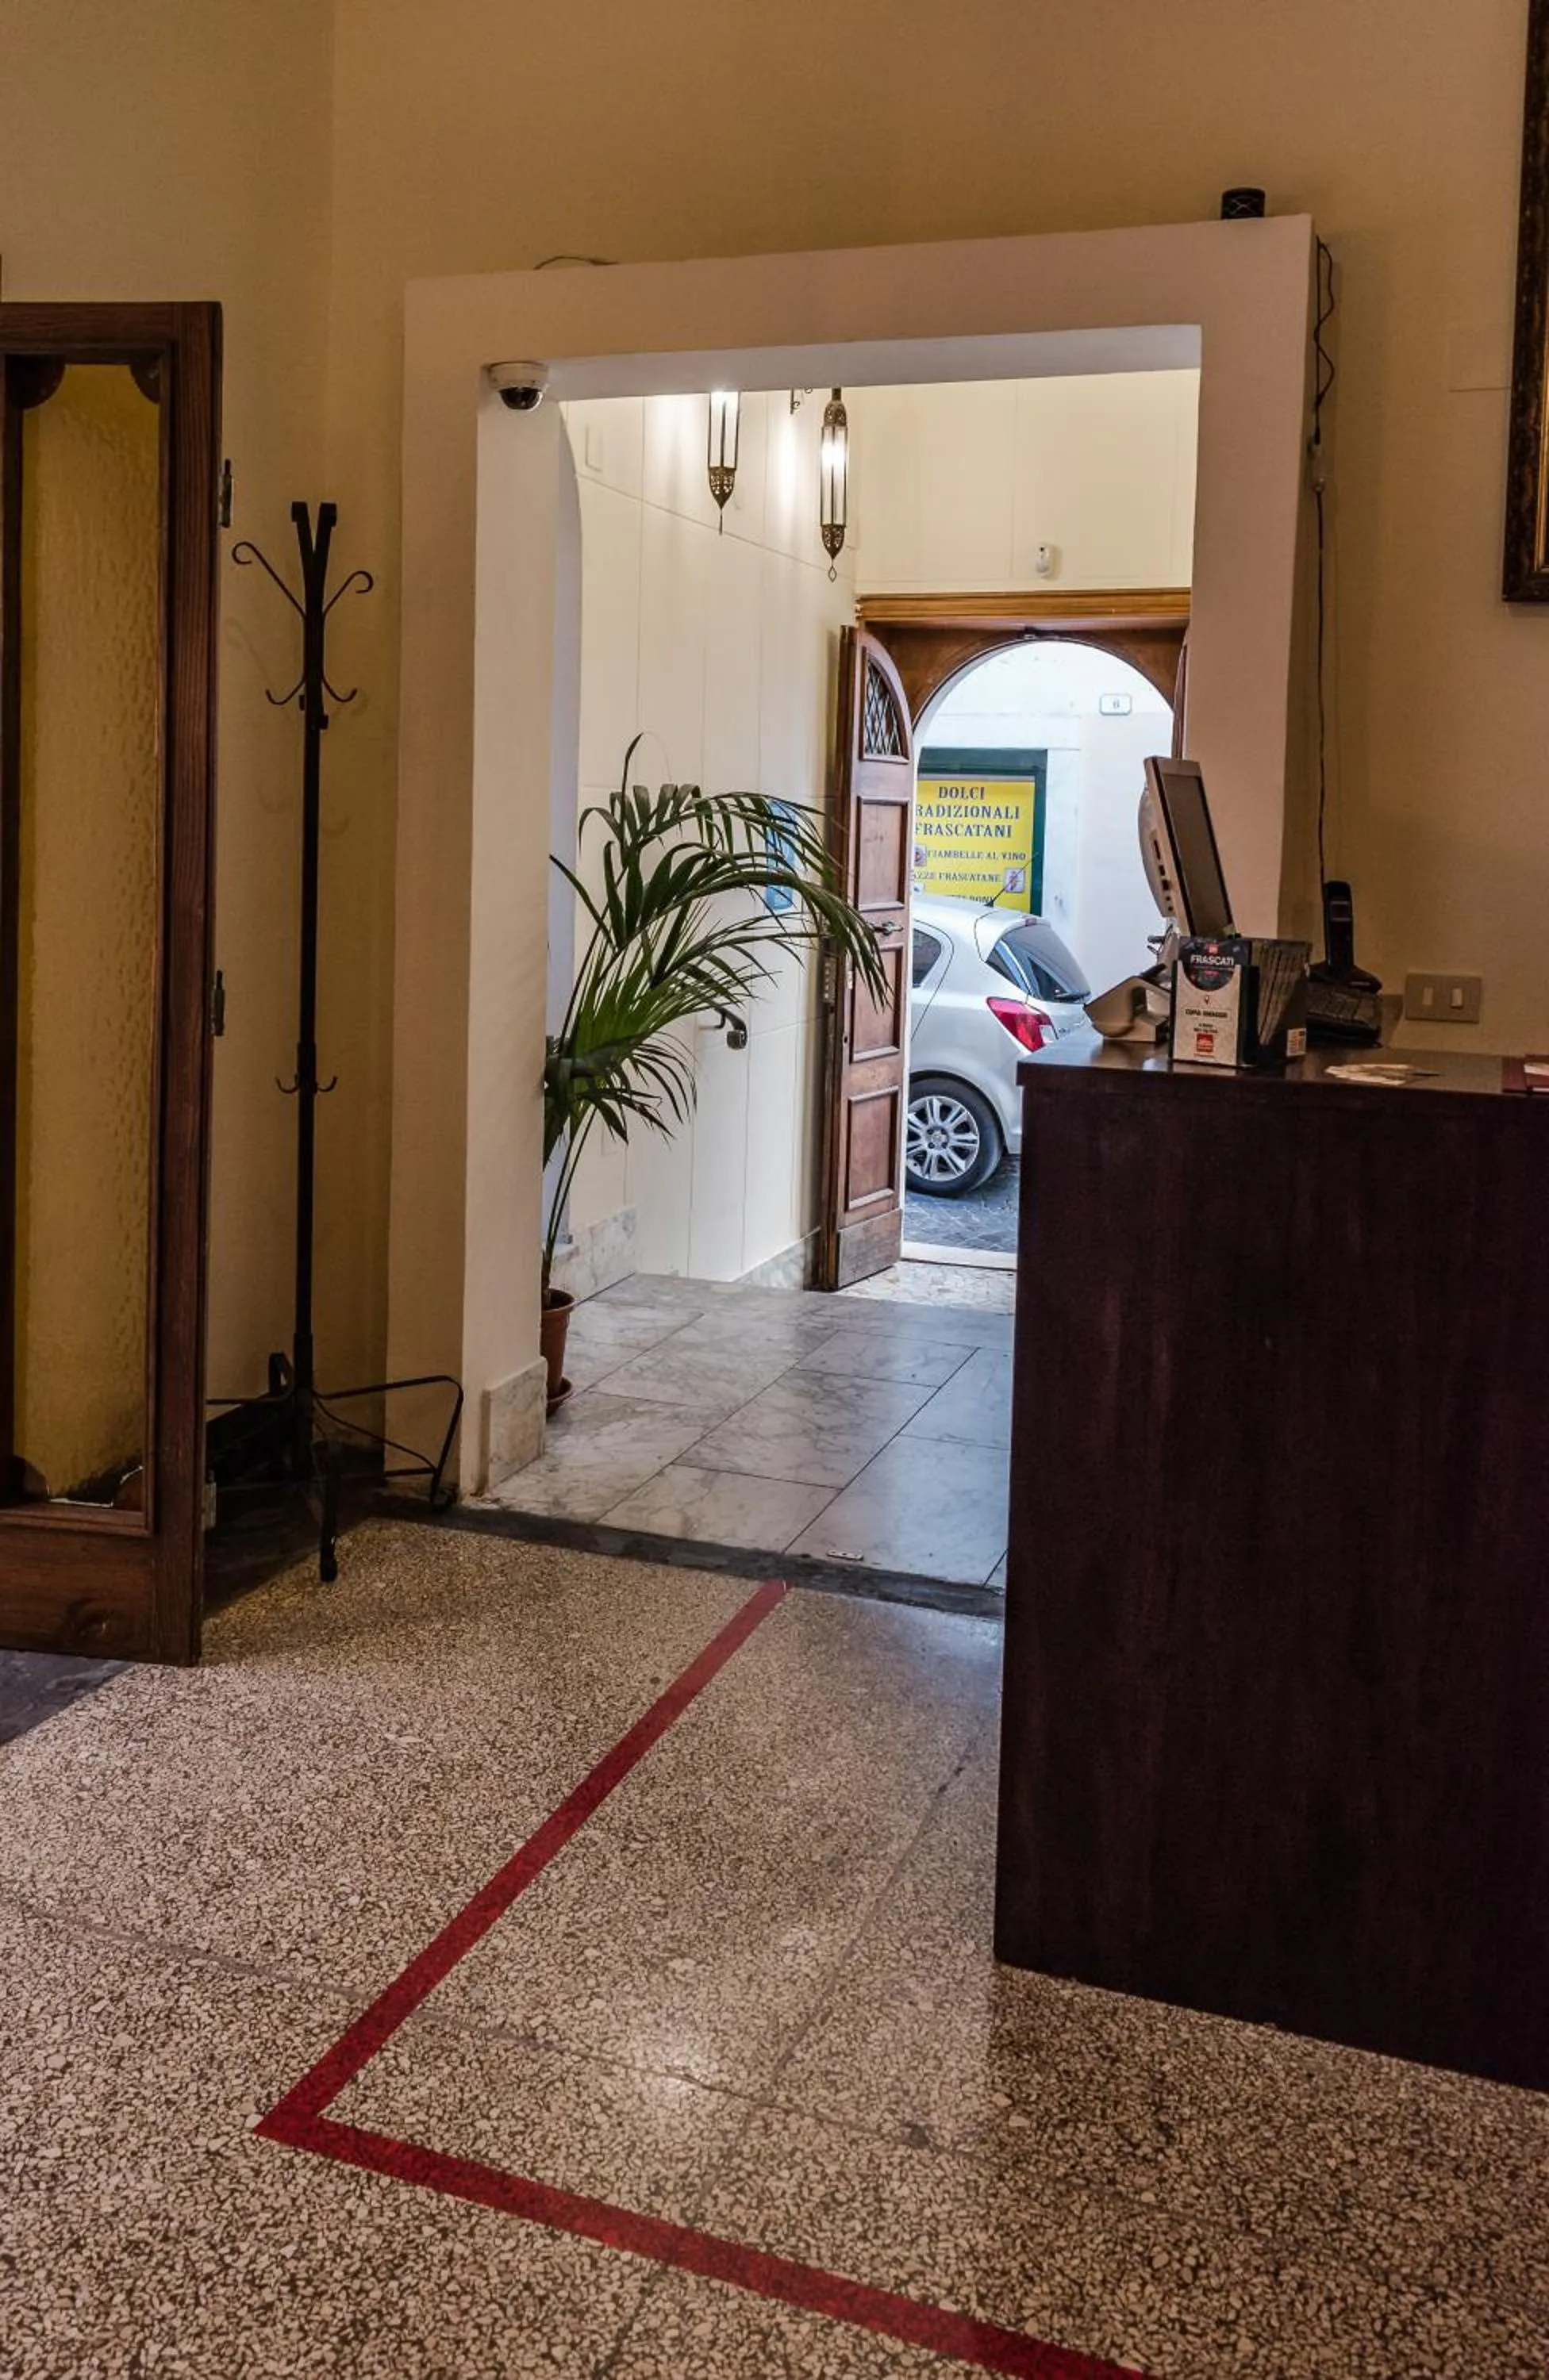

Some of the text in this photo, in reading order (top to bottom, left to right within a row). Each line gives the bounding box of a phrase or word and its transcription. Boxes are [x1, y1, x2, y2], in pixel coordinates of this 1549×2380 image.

[939, 786, 985, 800] DOLCI
[915, 804, 1020, 820] RADIZIONALI
[915, 822, 1012, 838] FRASCATANI
[1002, 851, 1026, 861] VINO
[1190, 954, 1235, 966] FRASCATI
